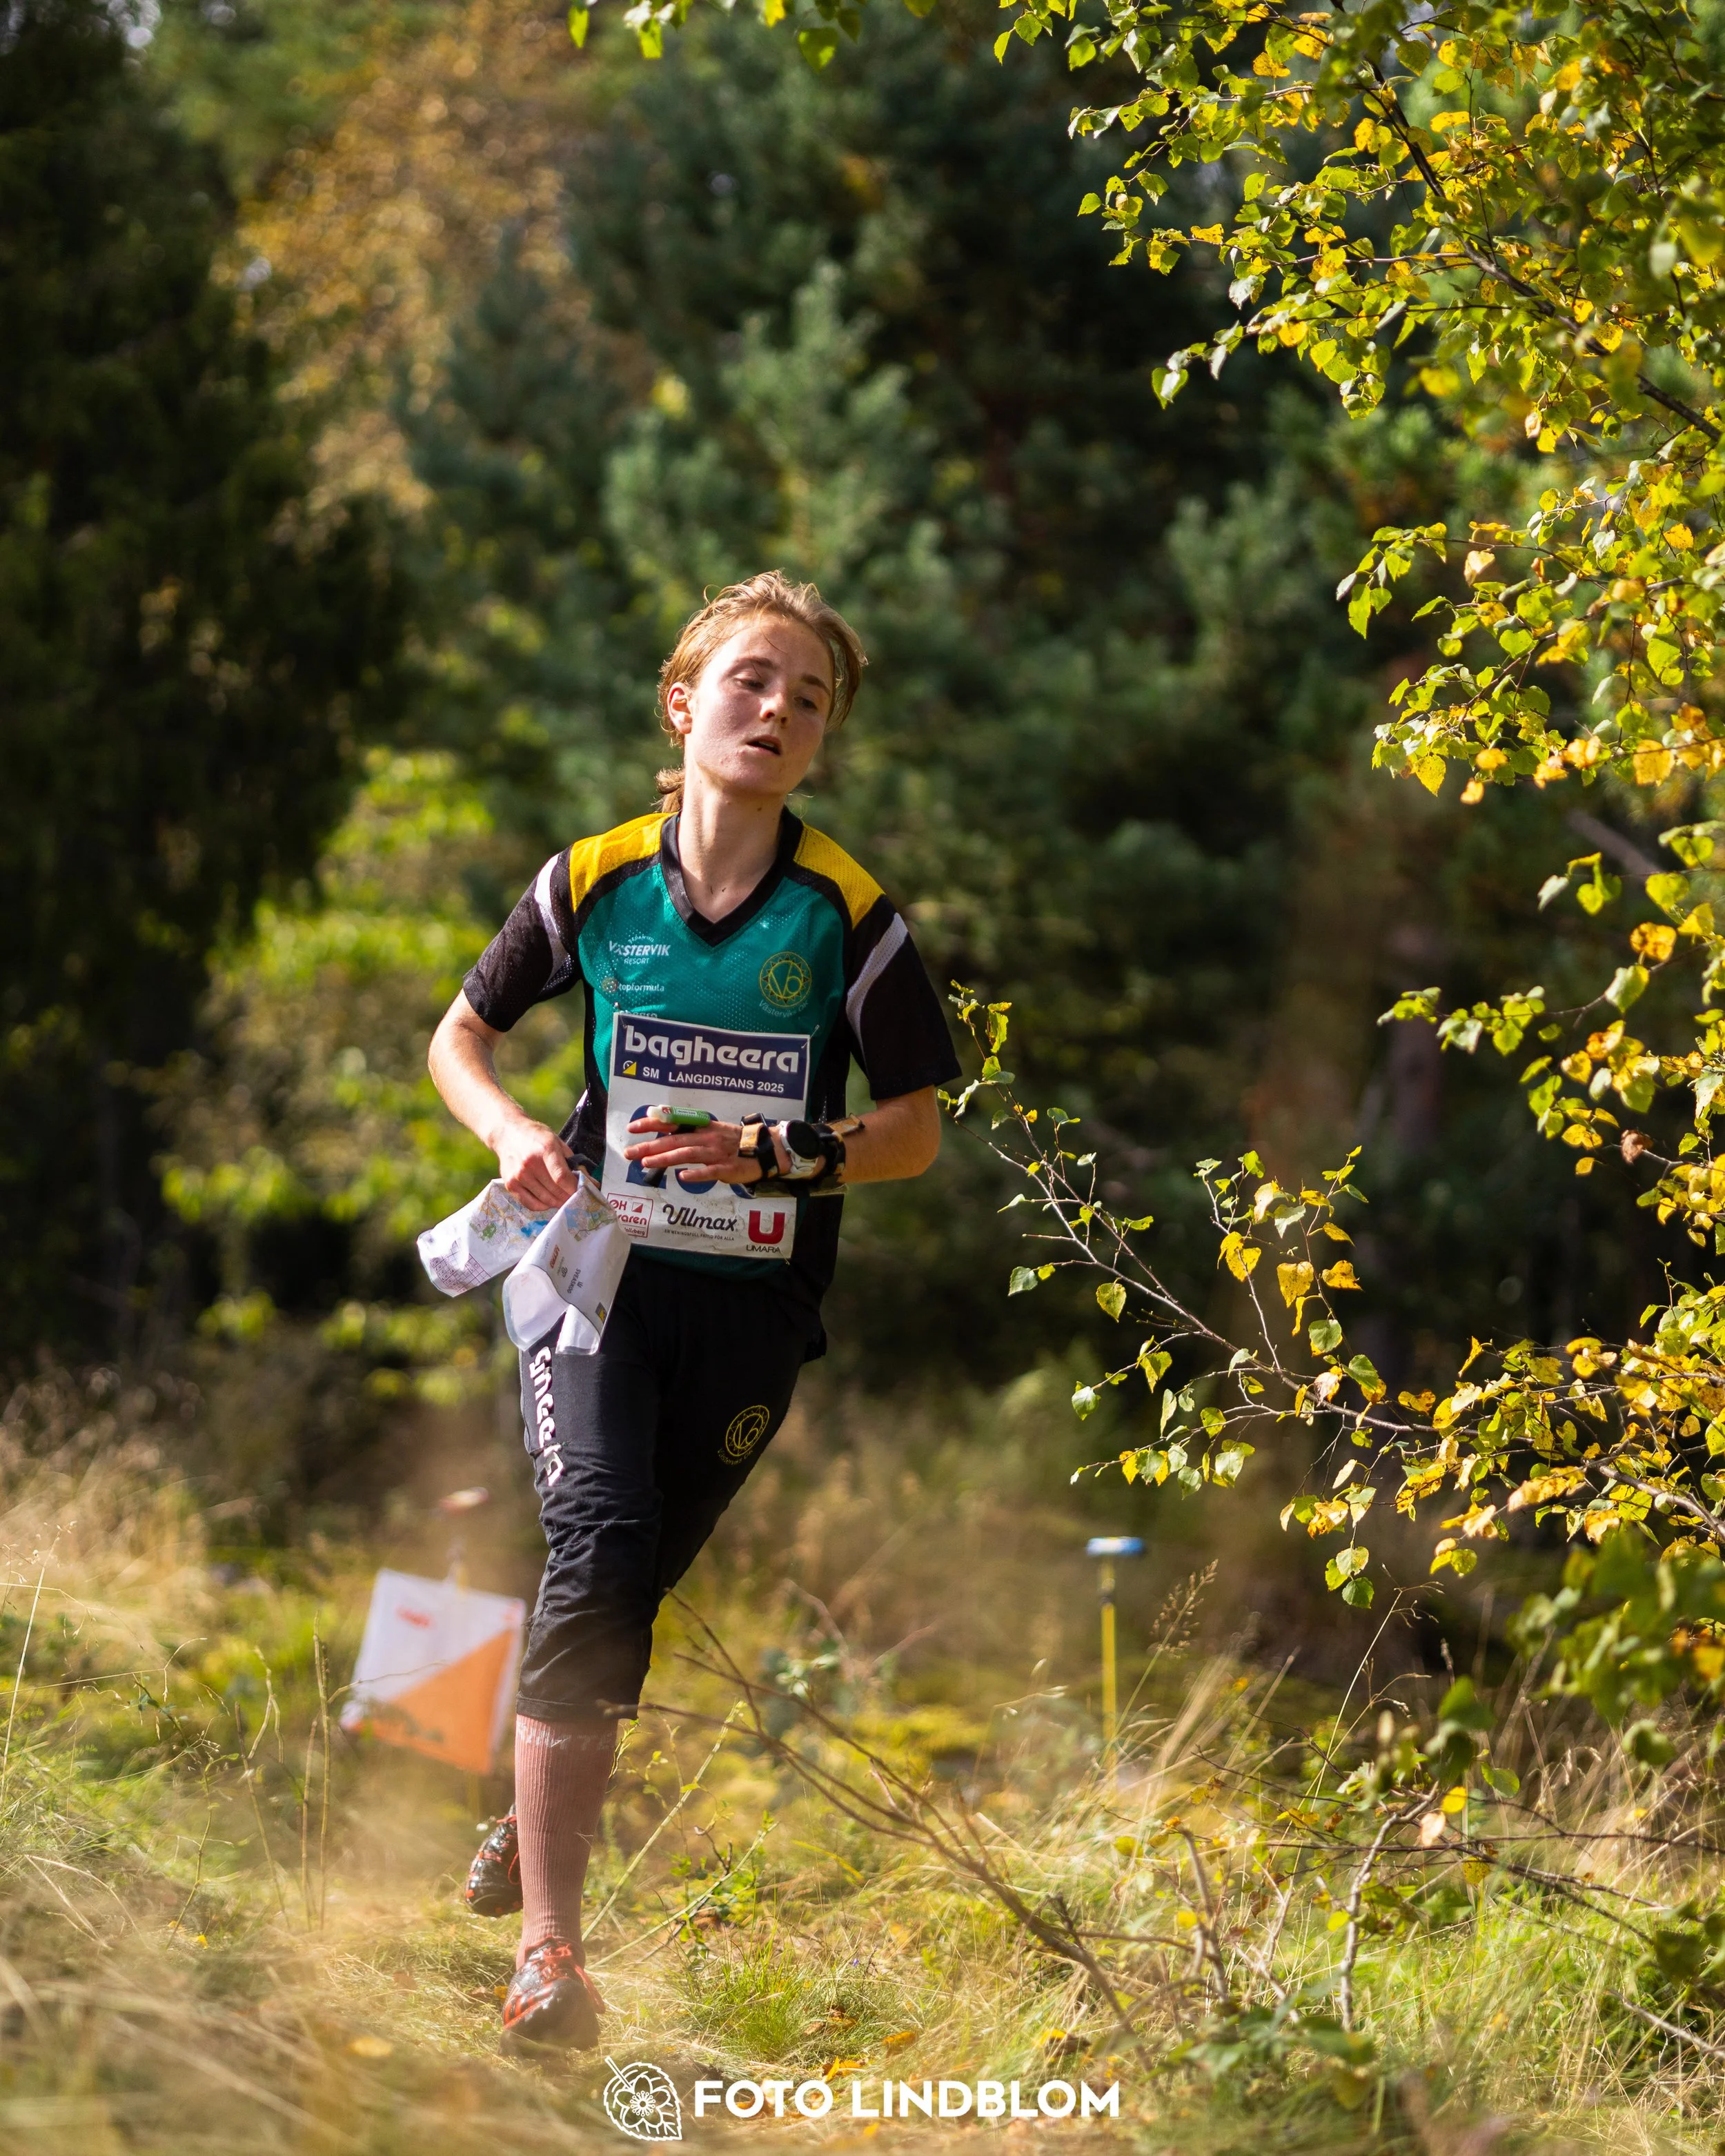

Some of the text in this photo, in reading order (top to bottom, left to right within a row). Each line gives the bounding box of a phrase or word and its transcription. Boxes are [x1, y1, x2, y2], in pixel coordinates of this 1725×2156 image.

[609, 940, 671, 956] VÄSTERVIK
[624, 957, 649, 965] RESORT
[625, 1025, 799, 1073] bagheera
[642, 1067, 784, 1093] SM LÅNGDISTANS 2025
[662, 1203, 738, 1232] Ullmax
[746, 1244, 781, 1253] UMARA
[566, 1268, 581, 1294] SVEASKOG
